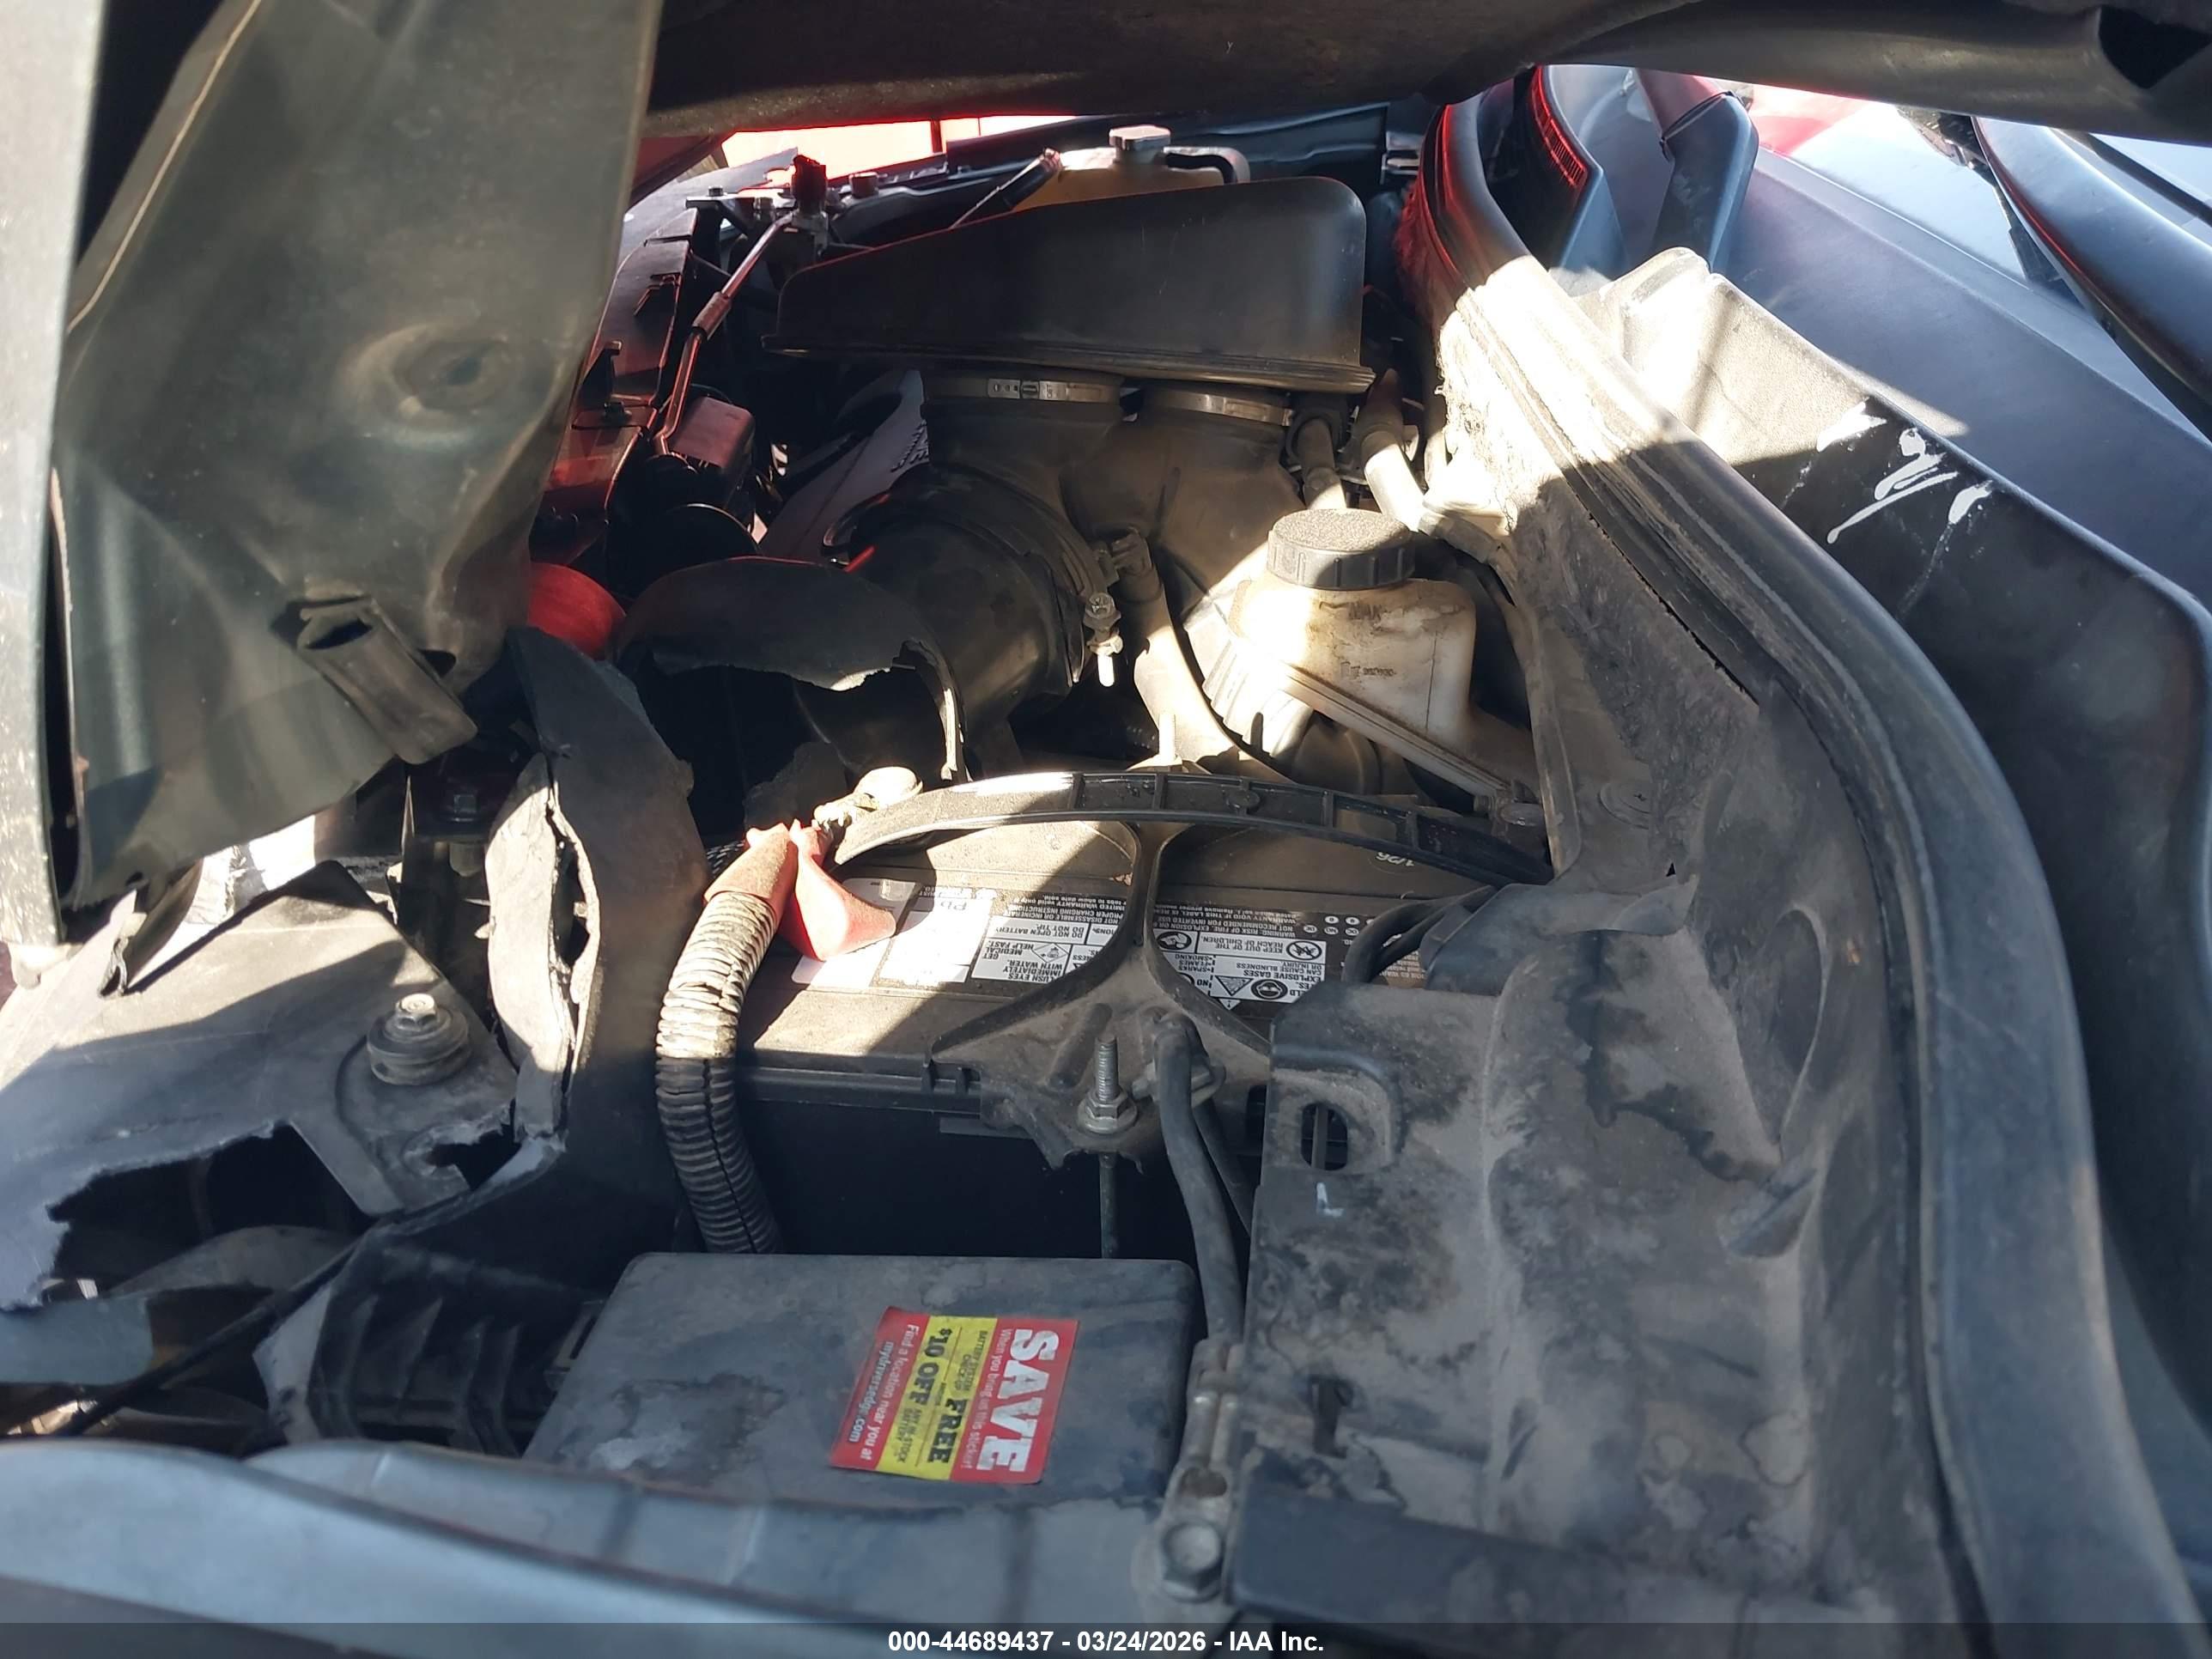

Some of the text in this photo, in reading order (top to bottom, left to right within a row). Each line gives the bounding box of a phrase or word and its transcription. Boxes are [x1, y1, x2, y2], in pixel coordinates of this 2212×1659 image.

[1055, 915, 1103, 923] DISASSEMBLE
[1223, 921, 1277, 930] RECOMMENDED
[1003, 966, 1060, 975] IMMEDIATELY
[1237, 963, 1278, 971] BLINDNESS
[1273, 973, 1321, 982] EXPLOSIVE
[902, 1324, 920, 1346] Find
[996, 1329, 1012, 1353] When
[908, 1328, 952, 1406] $10 OFF
[964, 1330, 988, 1391] BATTERY SYSTEM
[990, 1355, 1003, 1371] you
[882, 1358, 908, 1398] location
[980, 1374, 999, 1398] bring
[976, 1328, 1059, 1472] SAVE
[978, 1398, 990, 1411] us
[874, 1401, 890, 1424] near
[971, 1412, 988, 1430] this
[866, 1425, 881, 1446] you
[927, 1398, 967, 1463] FREE
[860, 1448, 872, 1460] at
